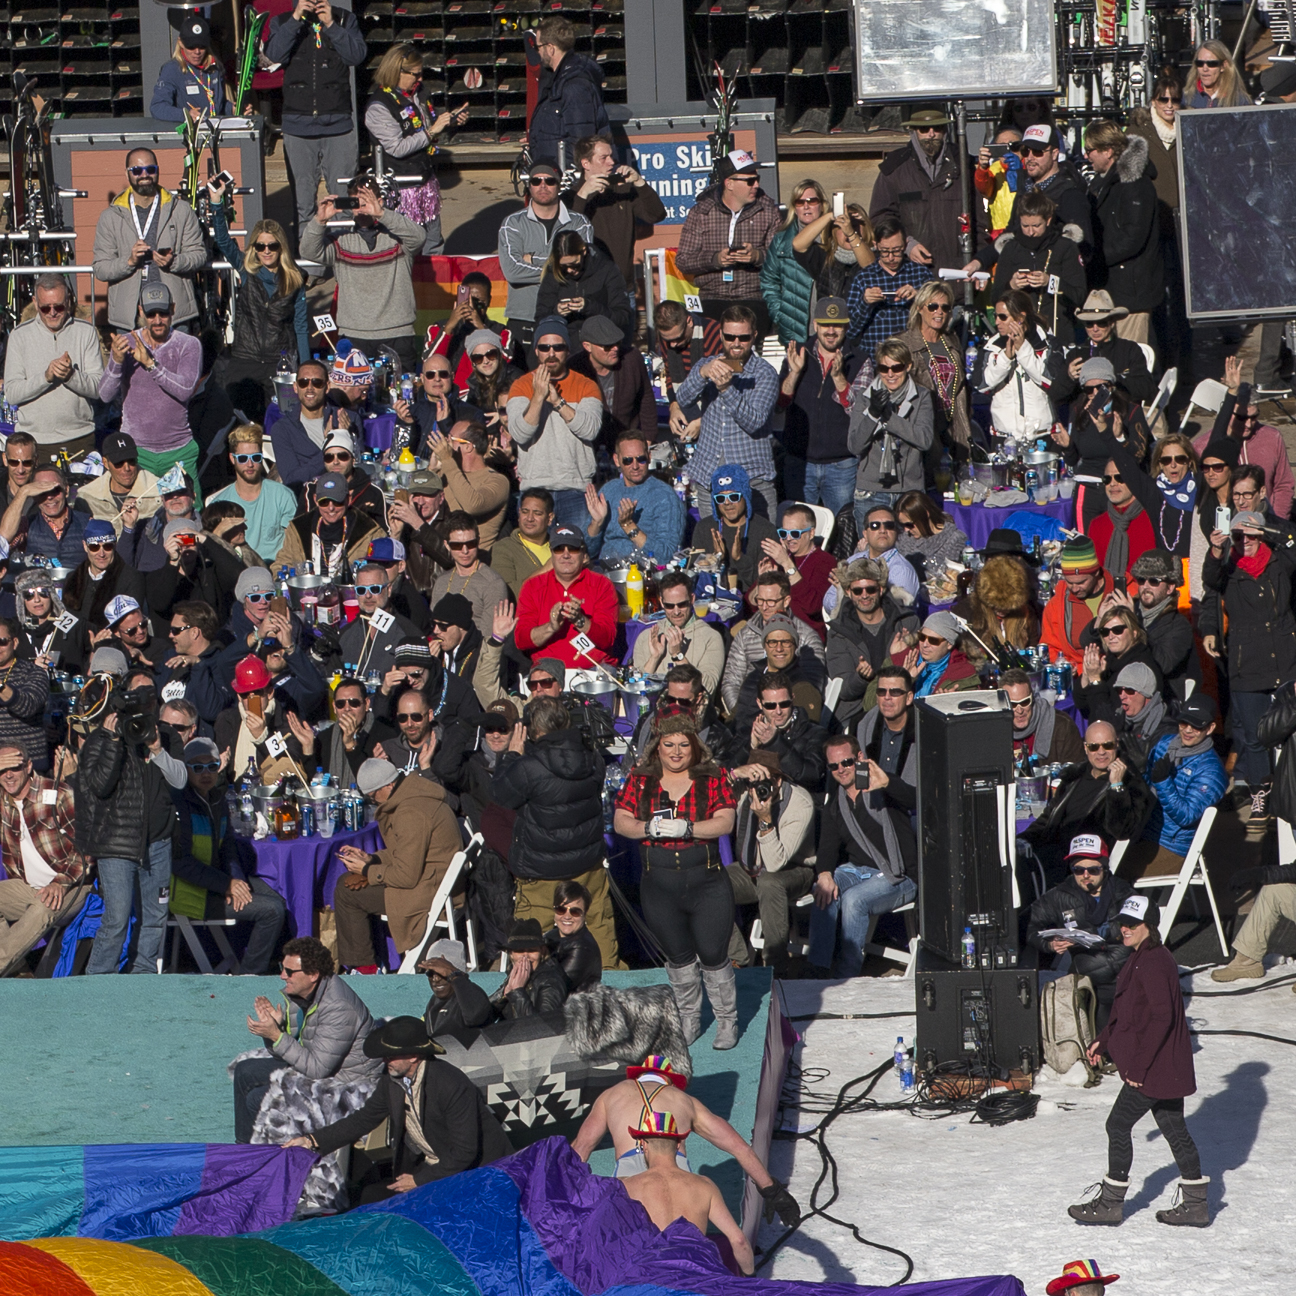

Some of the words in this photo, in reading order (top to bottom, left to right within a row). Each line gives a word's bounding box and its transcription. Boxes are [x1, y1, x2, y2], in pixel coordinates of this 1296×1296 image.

[676, 144, 711, 169] Ski
[646, 174, 708, 201] uning
[687, 297, 700, 309] 34
[317, 317, 333, 329] 35
[116, 439, 127, 448] H
[59, 615, 74, 629] 12
[375, 613, 390, 628] 11
[576, 636, 590, 650] 10
